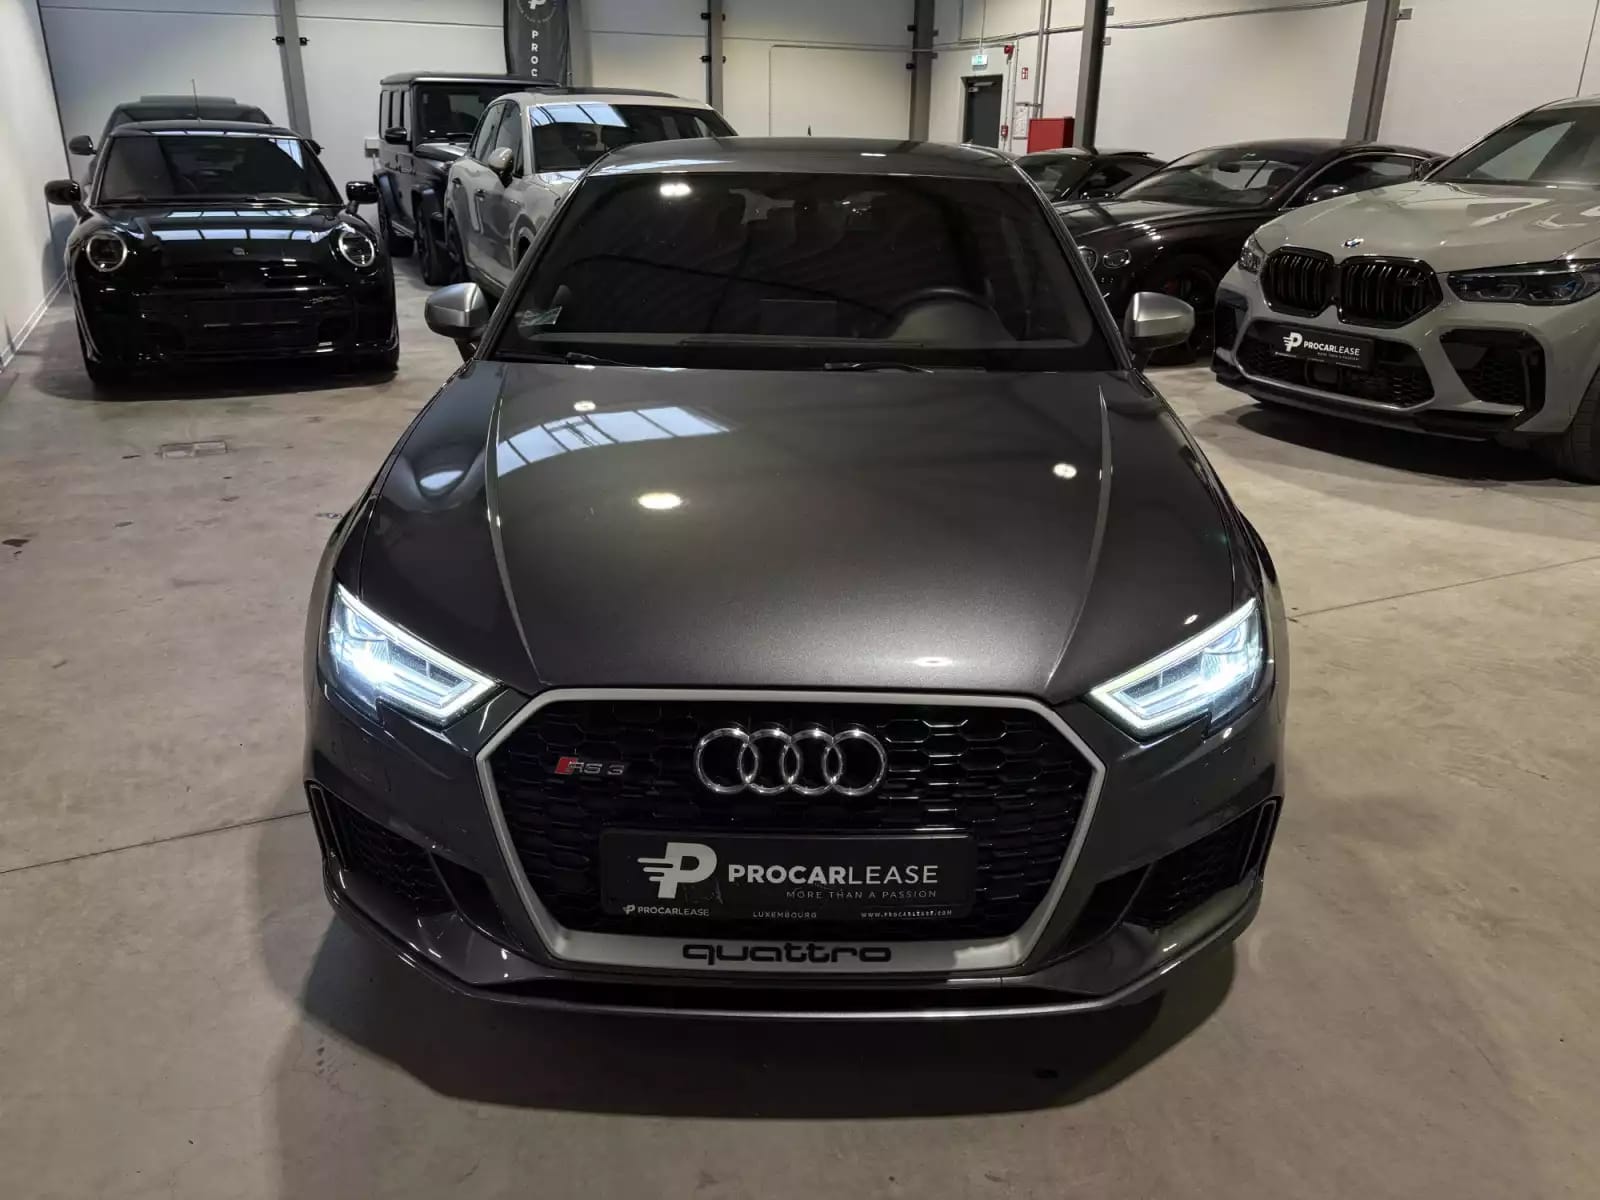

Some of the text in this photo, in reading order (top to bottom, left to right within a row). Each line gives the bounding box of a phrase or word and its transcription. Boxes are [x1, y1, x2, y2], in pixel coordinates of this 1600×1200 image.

[1304, 341, 1360, 356] PROCARLEASE
[728, 864, 939, 885] PROCARLEASE
[786, 889, 937, 899] MORE THAN A PASSION
[637, 906, 710, 917] PROCARLEASE
[752, 911, 818, 919] LUXEMBOURG
[682, 943, 892, 965] quattro
